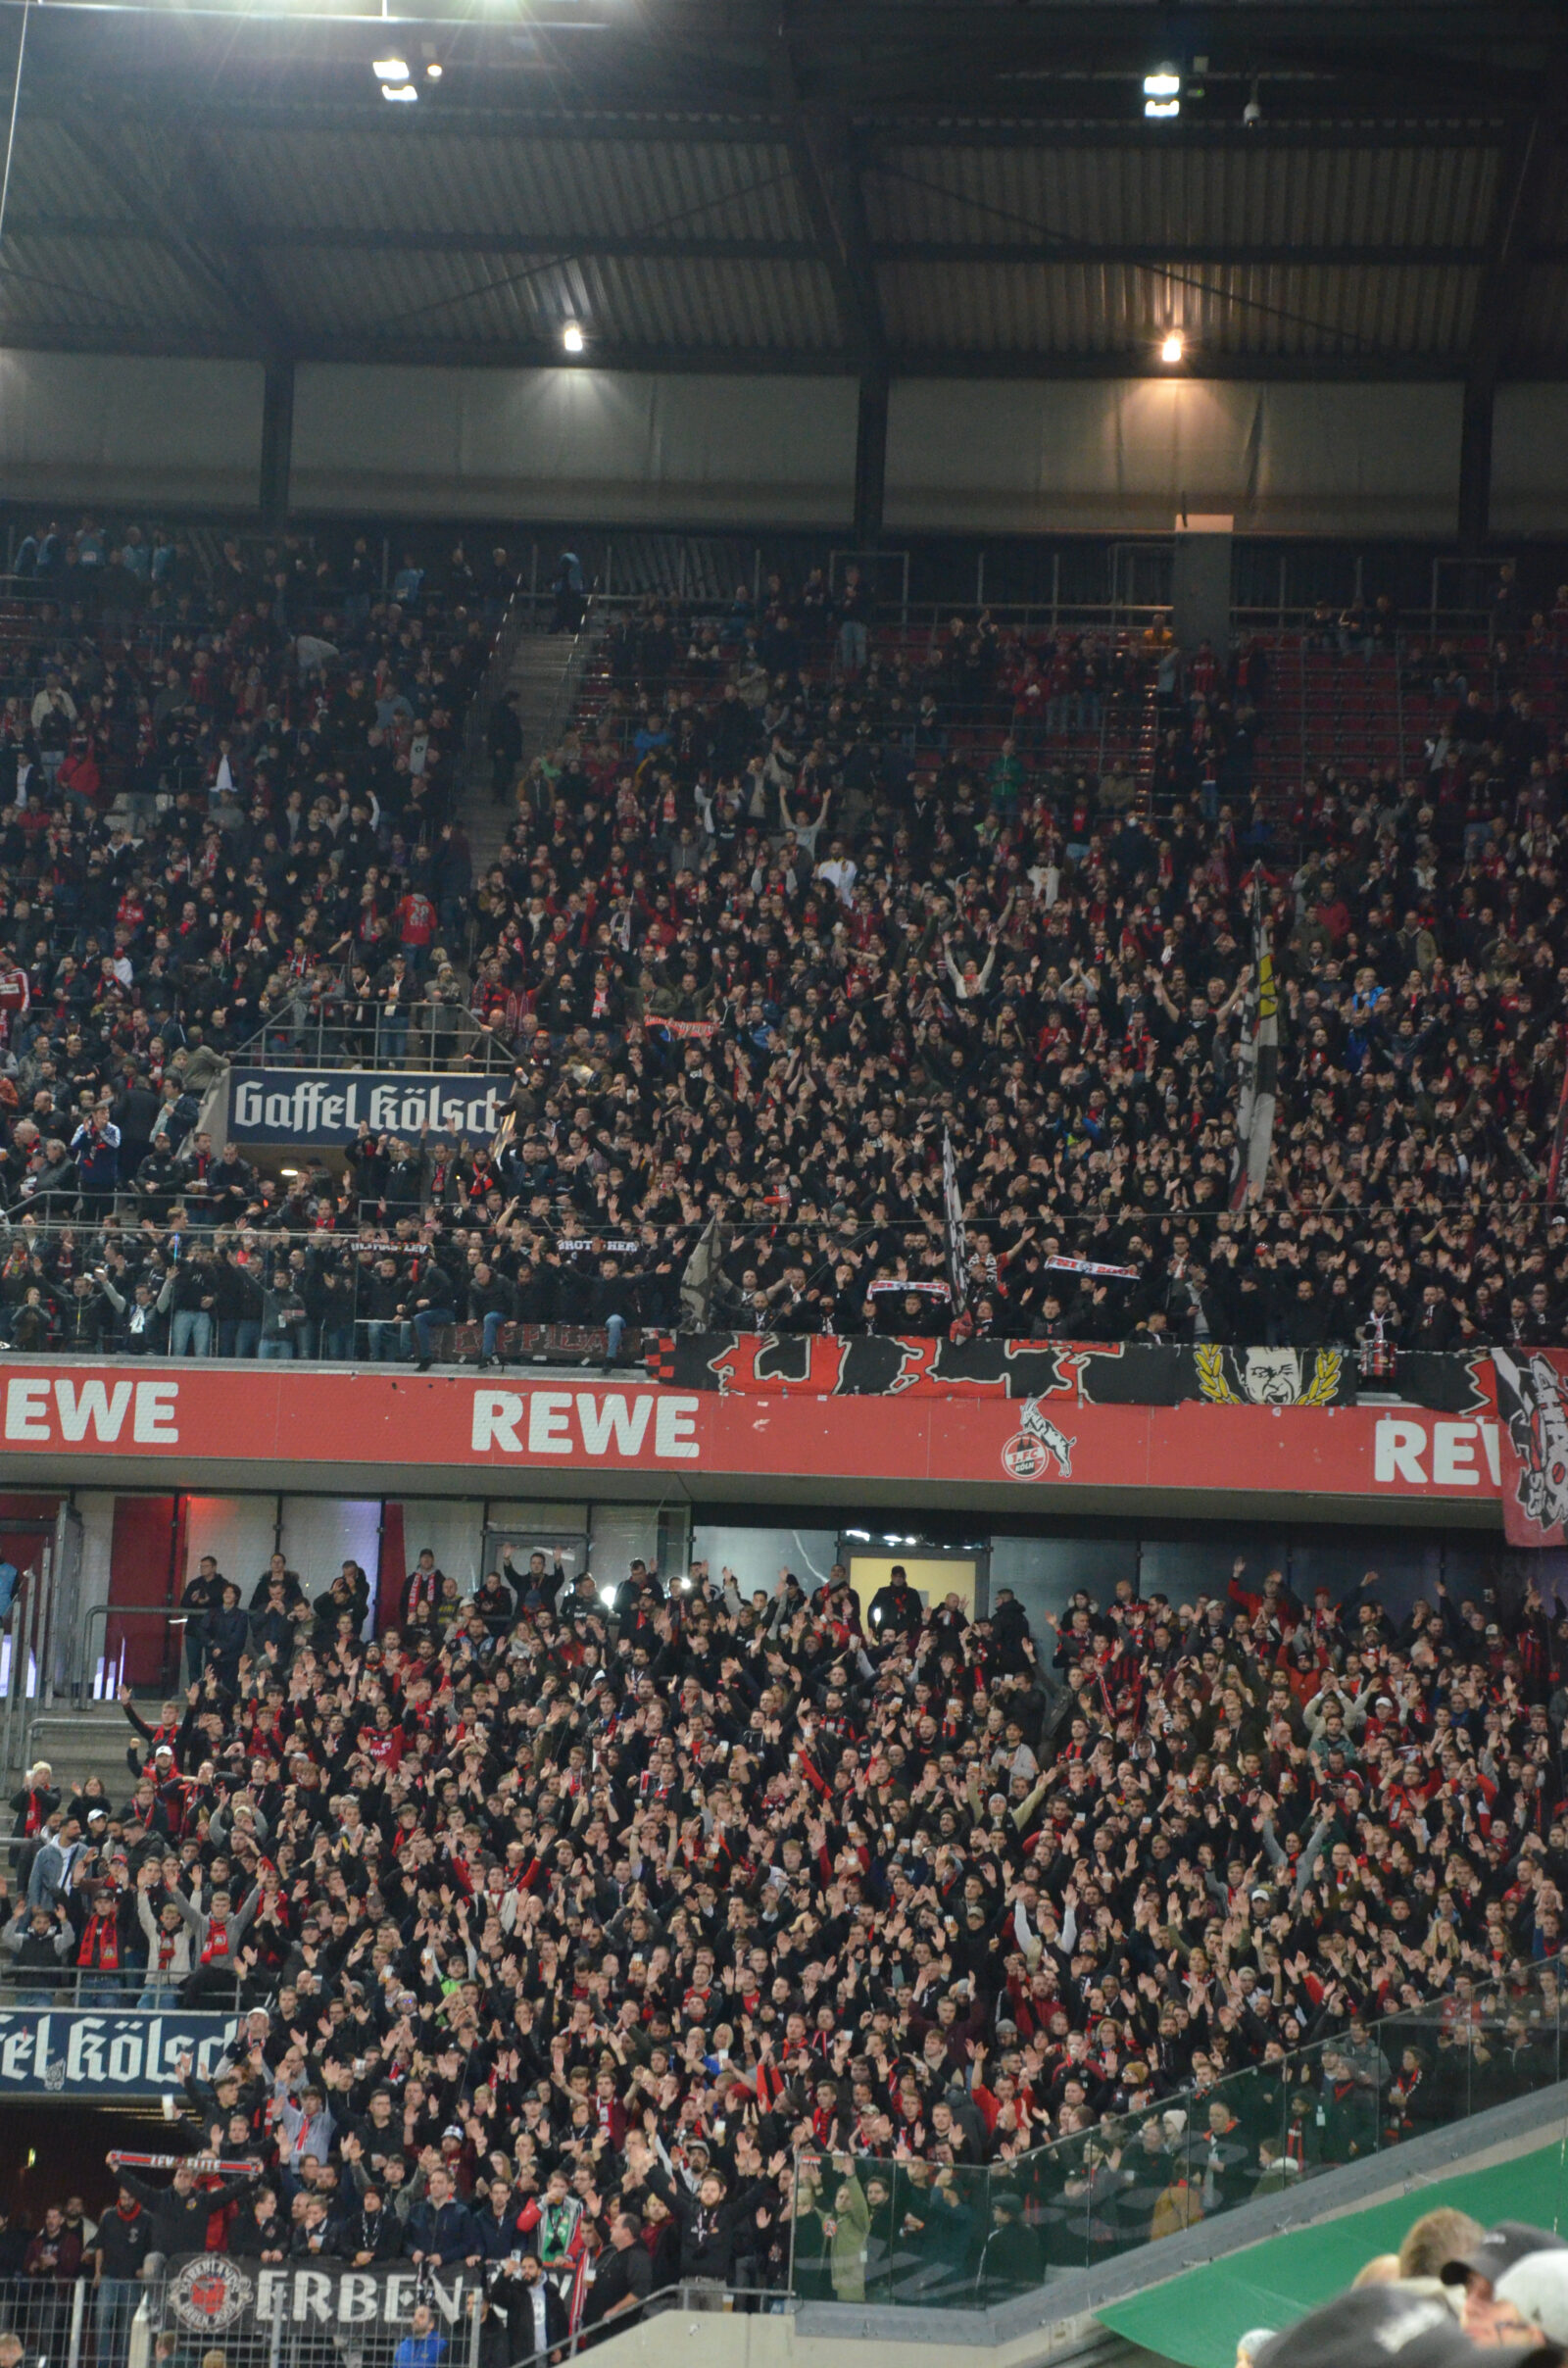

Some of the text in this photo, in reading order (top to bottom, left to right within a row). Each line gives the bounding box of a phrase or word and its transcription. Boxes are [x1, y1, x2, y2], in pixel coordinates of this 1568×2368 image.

[234, 1080, 362, 1133] Gaffel
[0, 1378, 179, 1443] EWE
[471, 1389, 700, 1457] REWE
[0, 2013, 52, 2081] el
[256, 2269, 464, 2326] ERBEN
